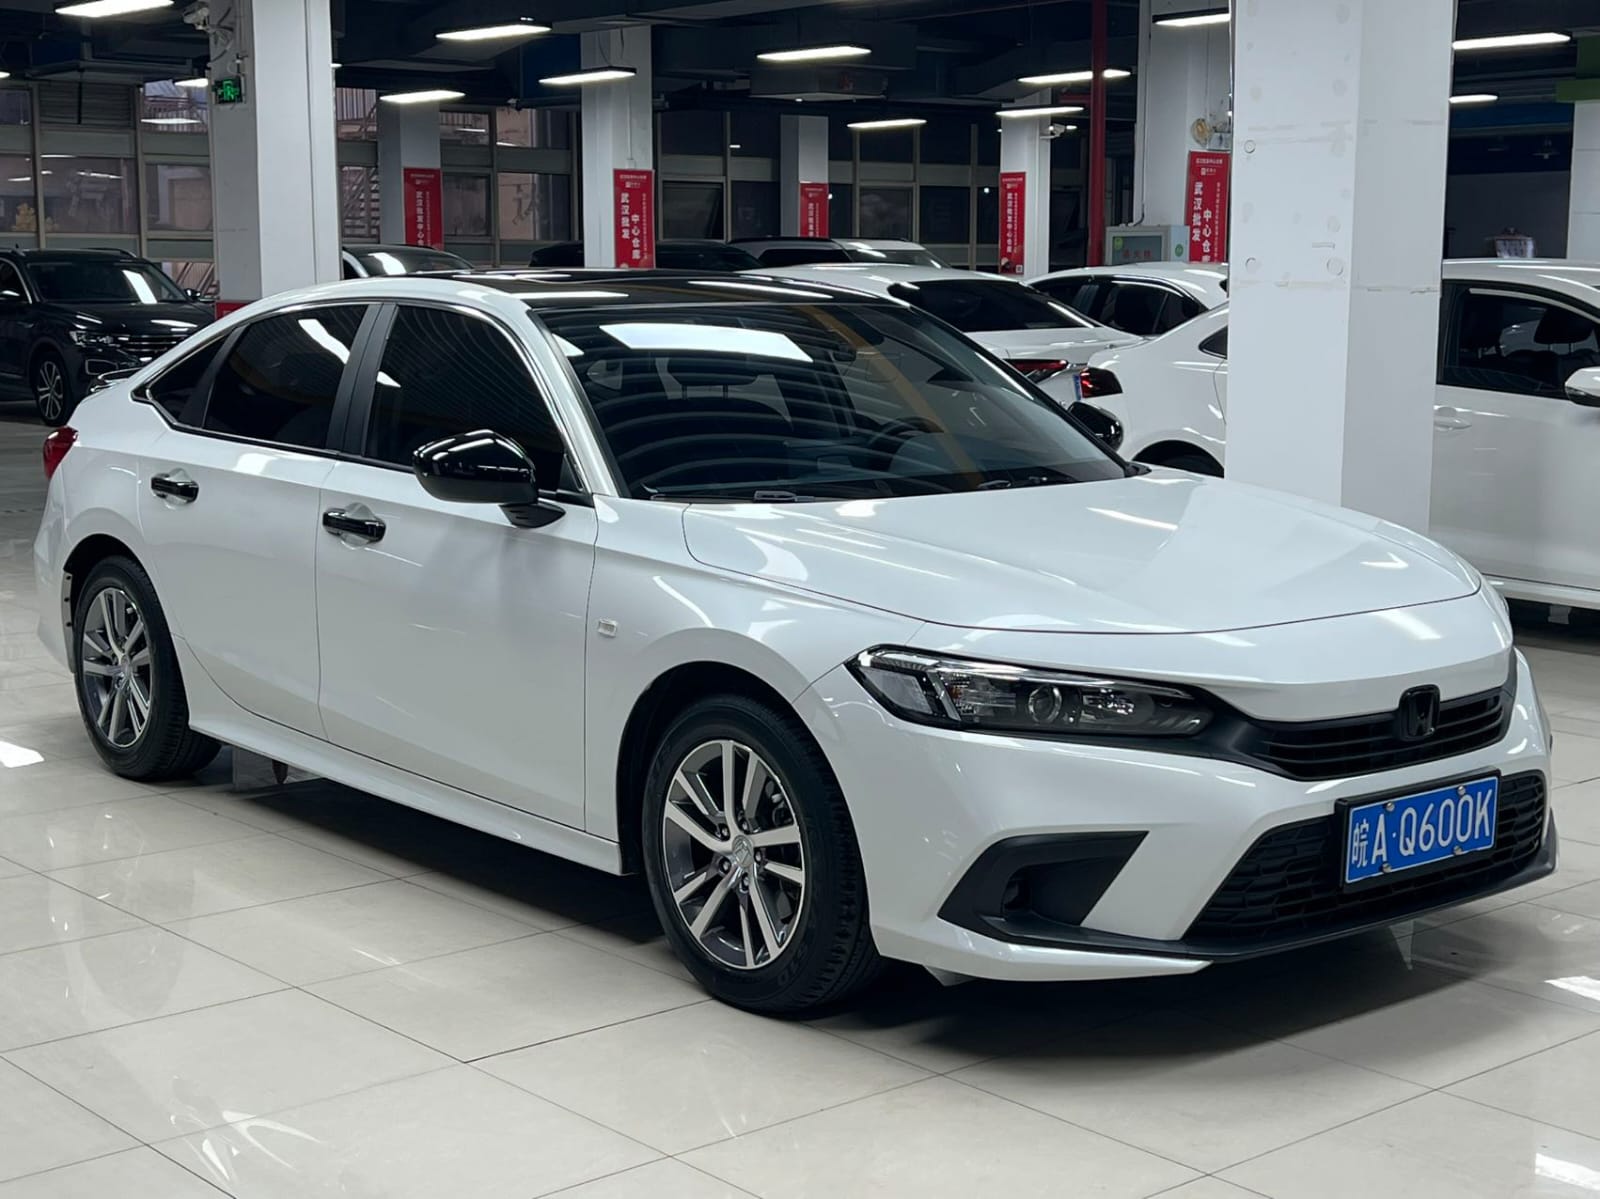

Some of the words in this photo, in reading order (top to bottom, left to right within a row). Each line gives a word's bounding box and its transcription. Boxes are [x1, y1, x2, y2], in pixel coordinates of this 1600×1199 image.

[621, 192, 630, 239] 武汉批发
[631, 213, 641, 259] 中心仓库
[1192, 181, 1203, 241] 武汉批发
[1351, 788, 1493, 869] 皖A·Q600K
